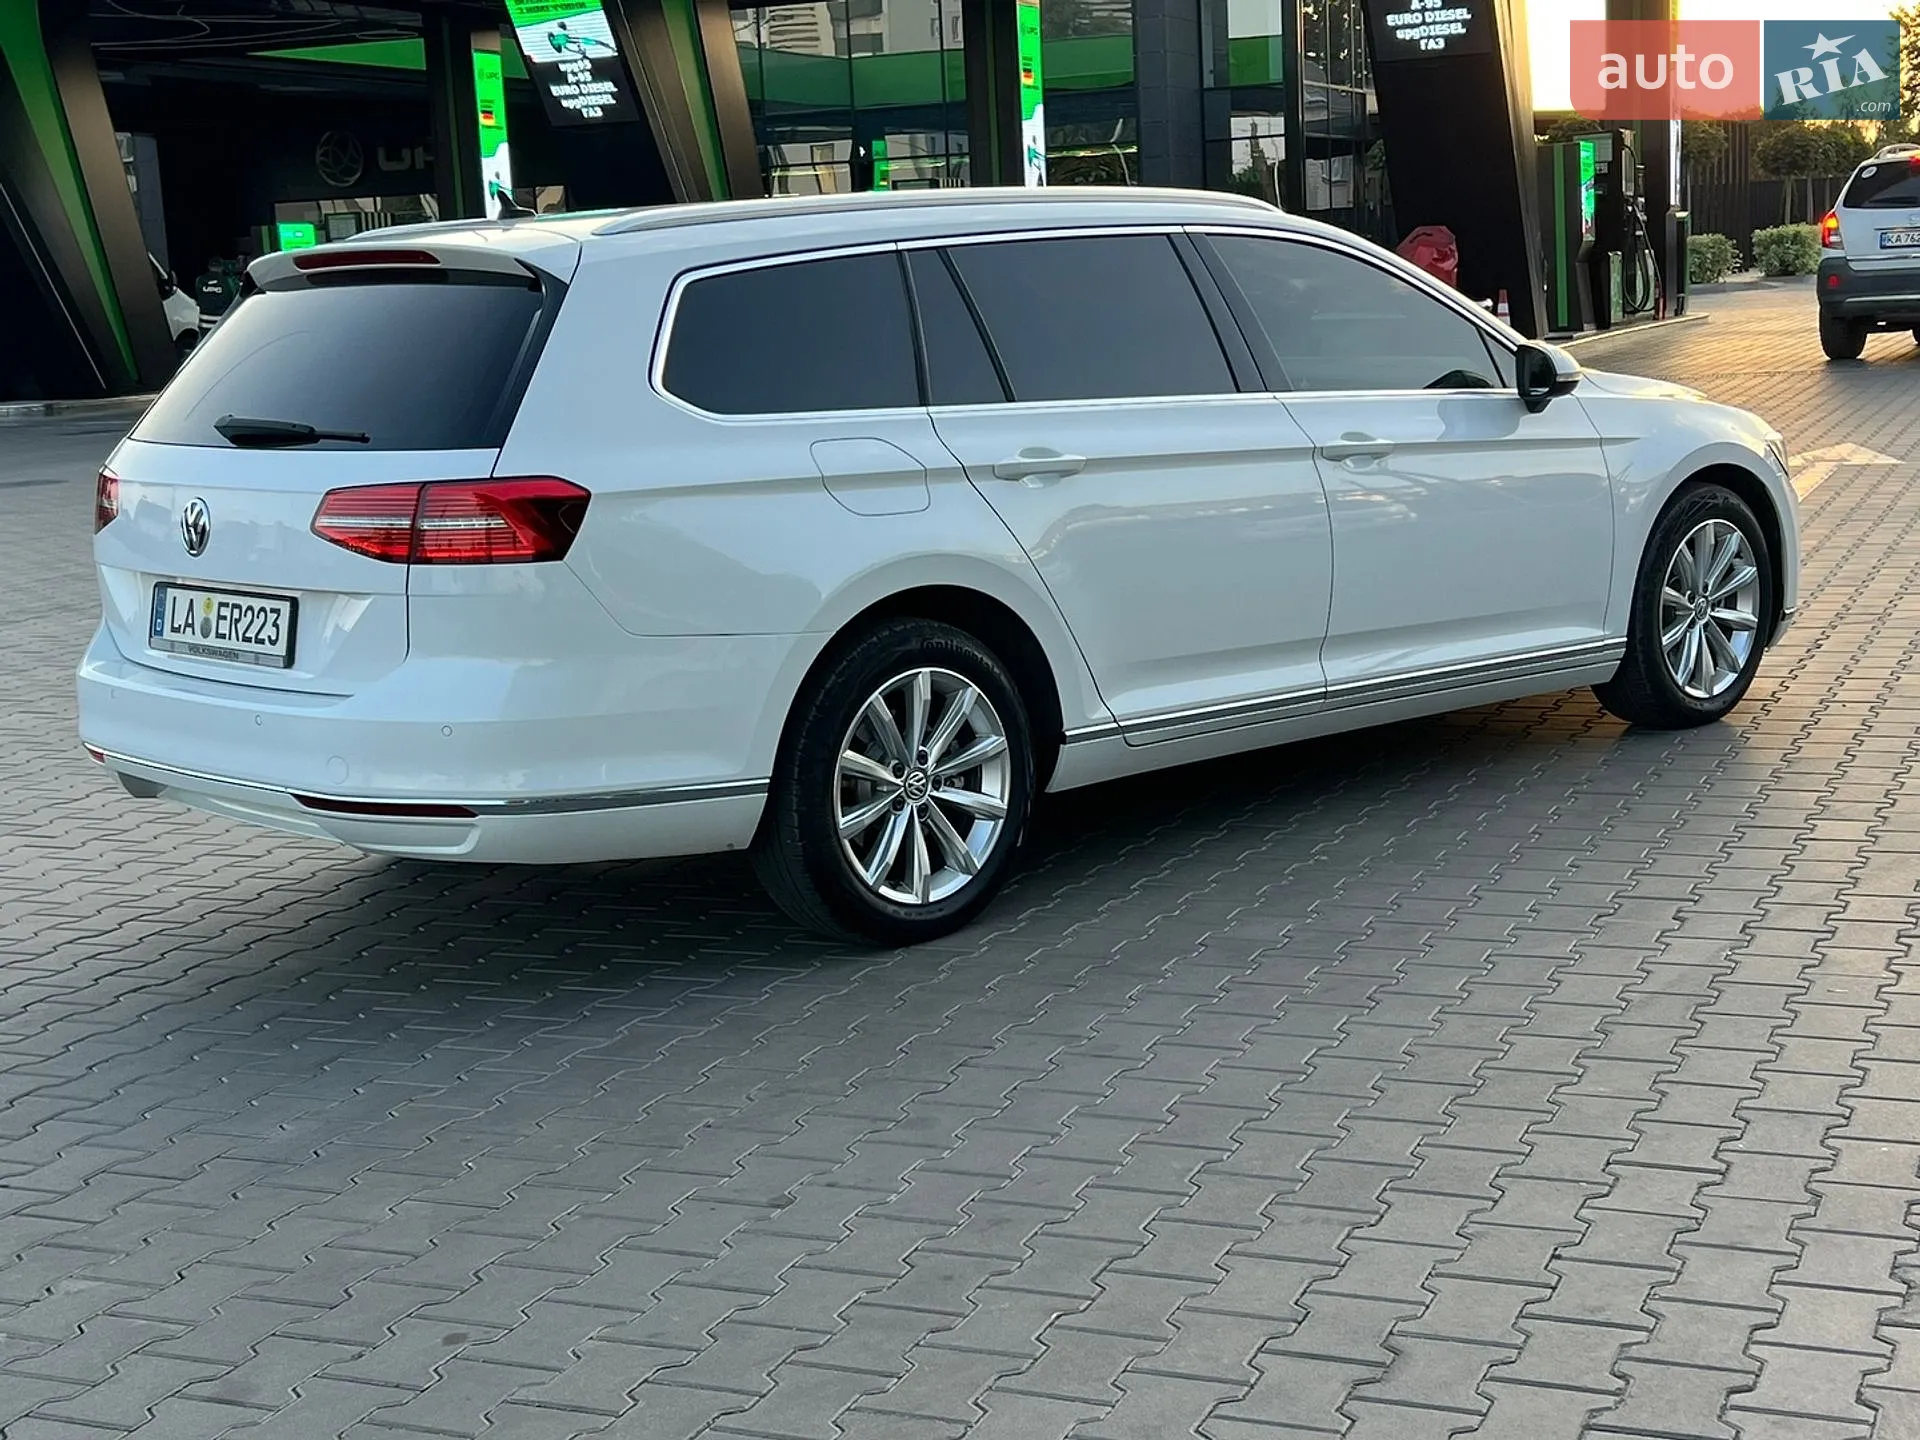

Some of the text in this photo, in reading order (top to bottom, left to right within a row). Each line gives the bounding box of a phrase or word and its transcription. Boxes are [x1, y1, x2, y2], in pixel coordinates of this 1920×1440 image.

[1386, 8, 1472, 26] EURO DIESEL
[1396, 22, 1466, 40] upgDIESEL
[567, 71, 592, 83] A-95
[549, 81, 618, 97] EURO DIESEL
[561, 94, 616, 109] upgDIESEL
[170, 596, 281, 646] LA ER223
[188, 645, 240, 661] VOLKSWAGEN
